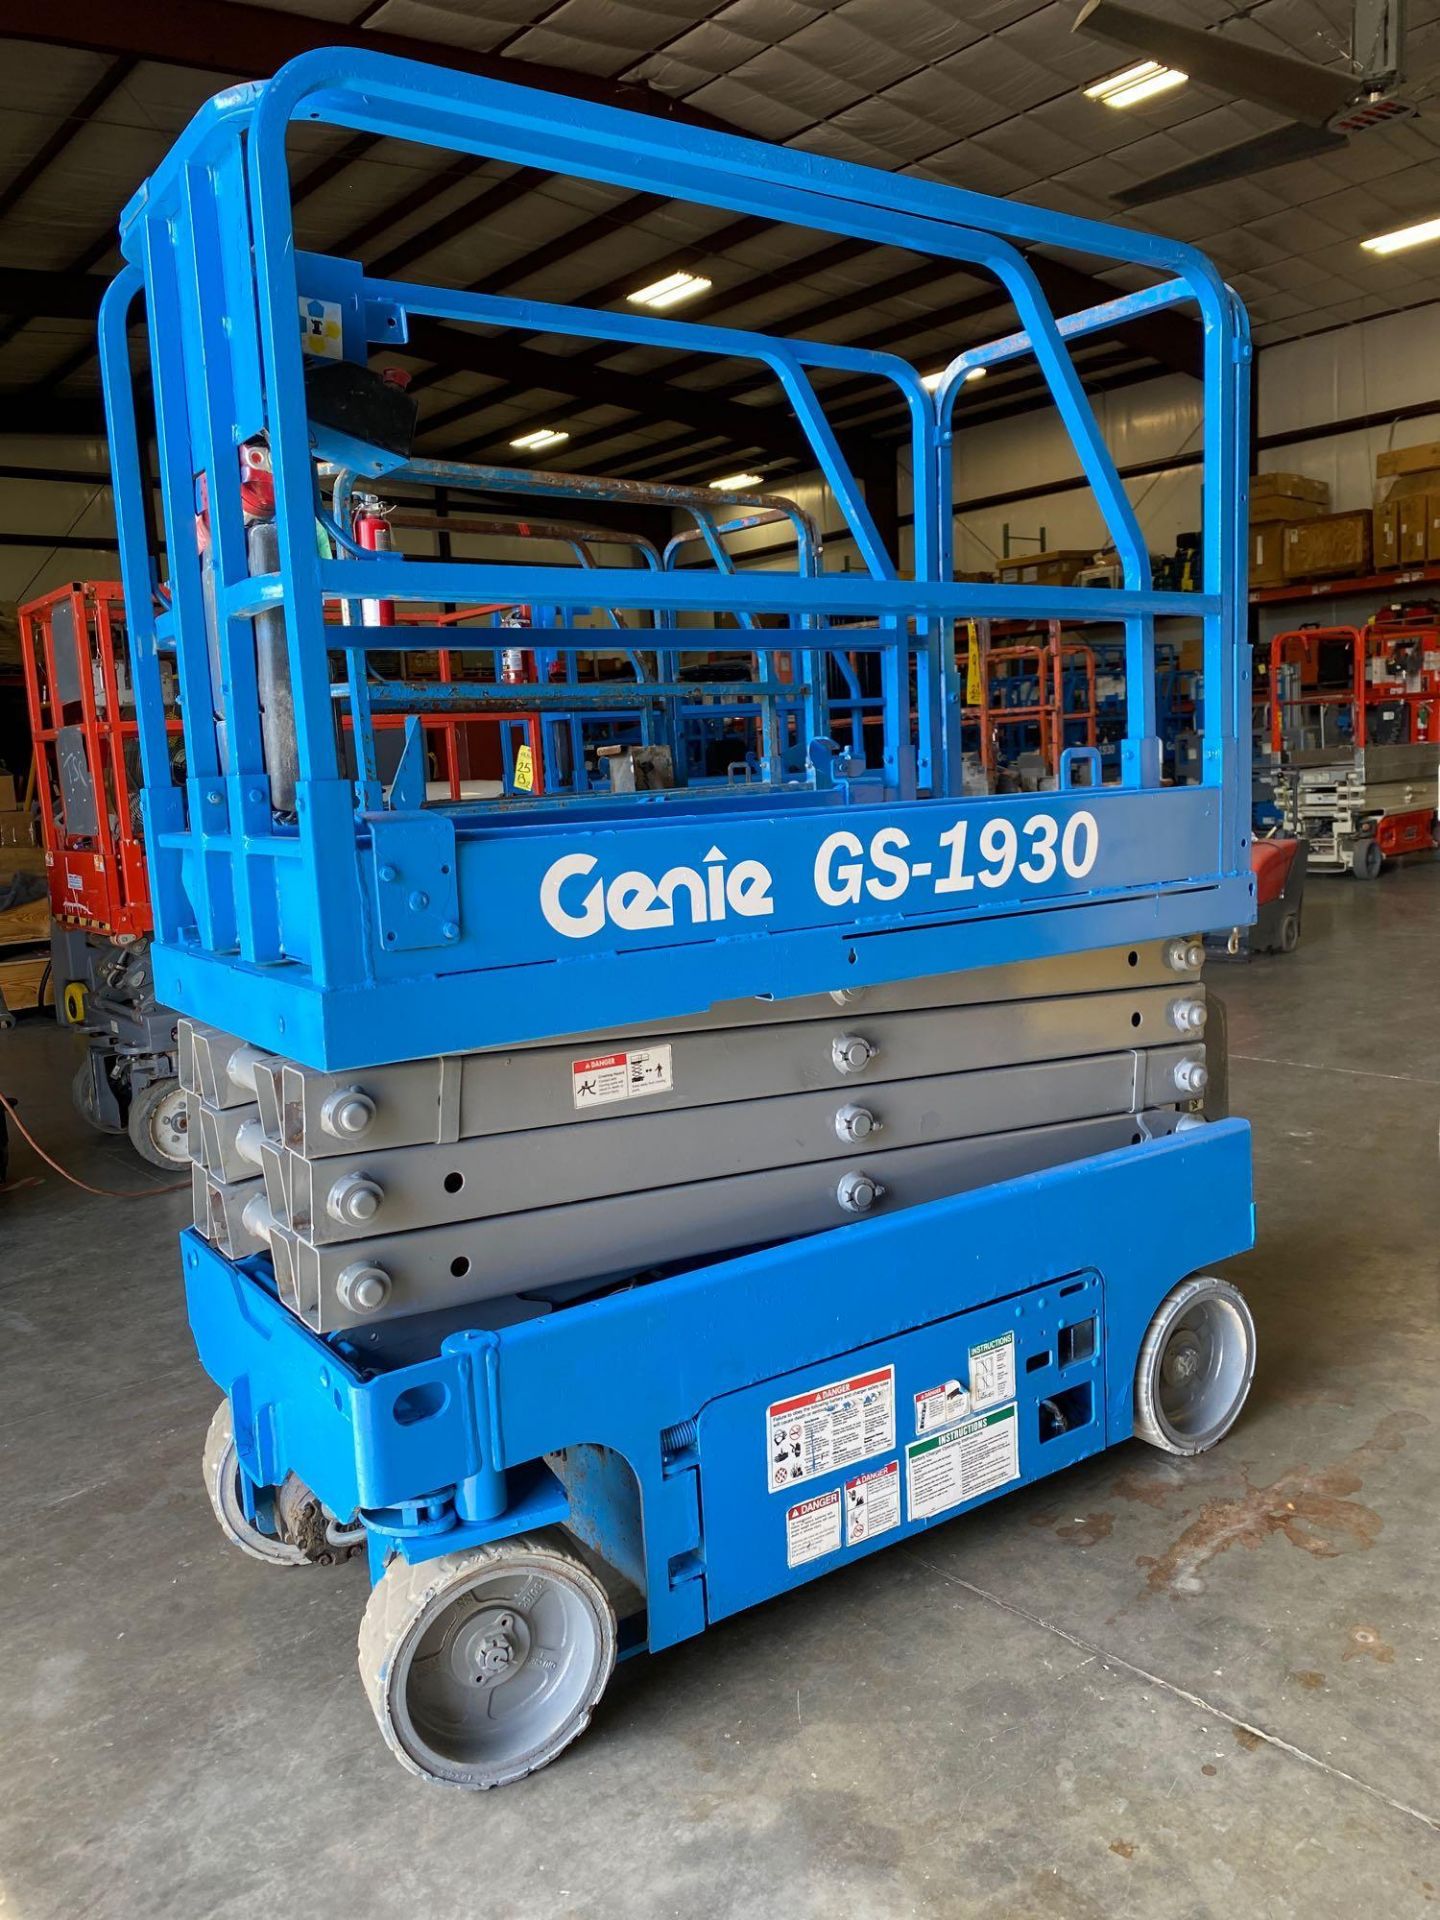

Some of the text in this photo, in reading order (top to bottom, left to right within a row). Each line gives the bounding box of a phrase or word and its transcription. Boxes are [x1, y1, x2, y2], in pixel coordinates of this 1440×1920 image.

[540, 810, 1099, 938] Genie GS-1930
[591, 1057, 616, 1068] DANGER
[971, 1334, 1012, 1355] INSTRUCTIONS
[822, 1383, 851, 1400] DANGER
[938, 1418, 988, 1446] INSTRUCTIONS
[861, 1467, 889, 1483] DANGER
[800, 1493, 838, 1513] DANGER
